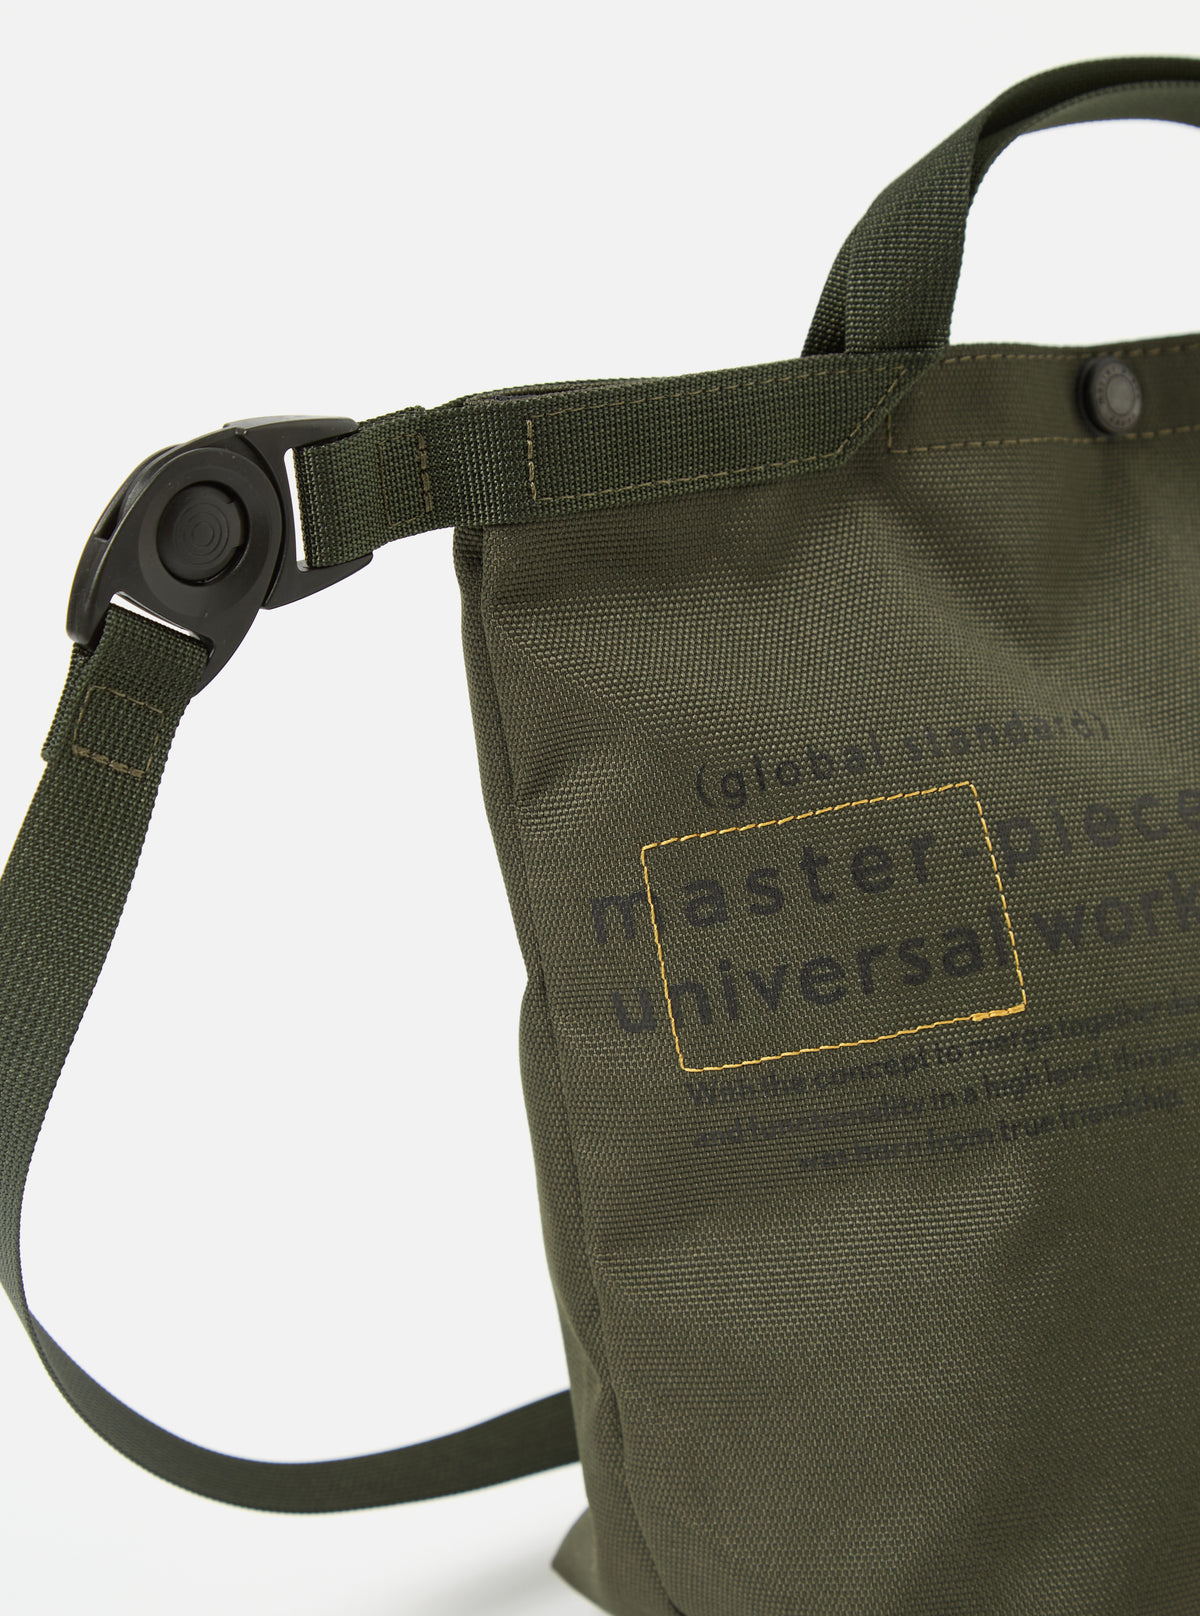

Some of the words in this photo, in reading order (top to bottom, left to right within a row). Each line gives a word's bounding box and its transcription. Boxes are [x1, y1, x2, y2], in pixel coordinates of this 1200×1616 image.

[695, 731, 884, 809] (global
[903, 709, 1113, 761] standard)
[610, 905, 1010, 1033] universal
[760, 1068, 806, 1097] the
[813, 1044, 929, 1091] concept
[935, 1041, 962, 1064] to
[968, 1022, 1053, 1058] merge
[930, 1088, 956, 1111] in
[962, 1087, 978, 1105] a
[982, 1063, 1040, 1100] high
[926, 1128, 994, 1154] from
[999, 1118, 1056, 1143] true
